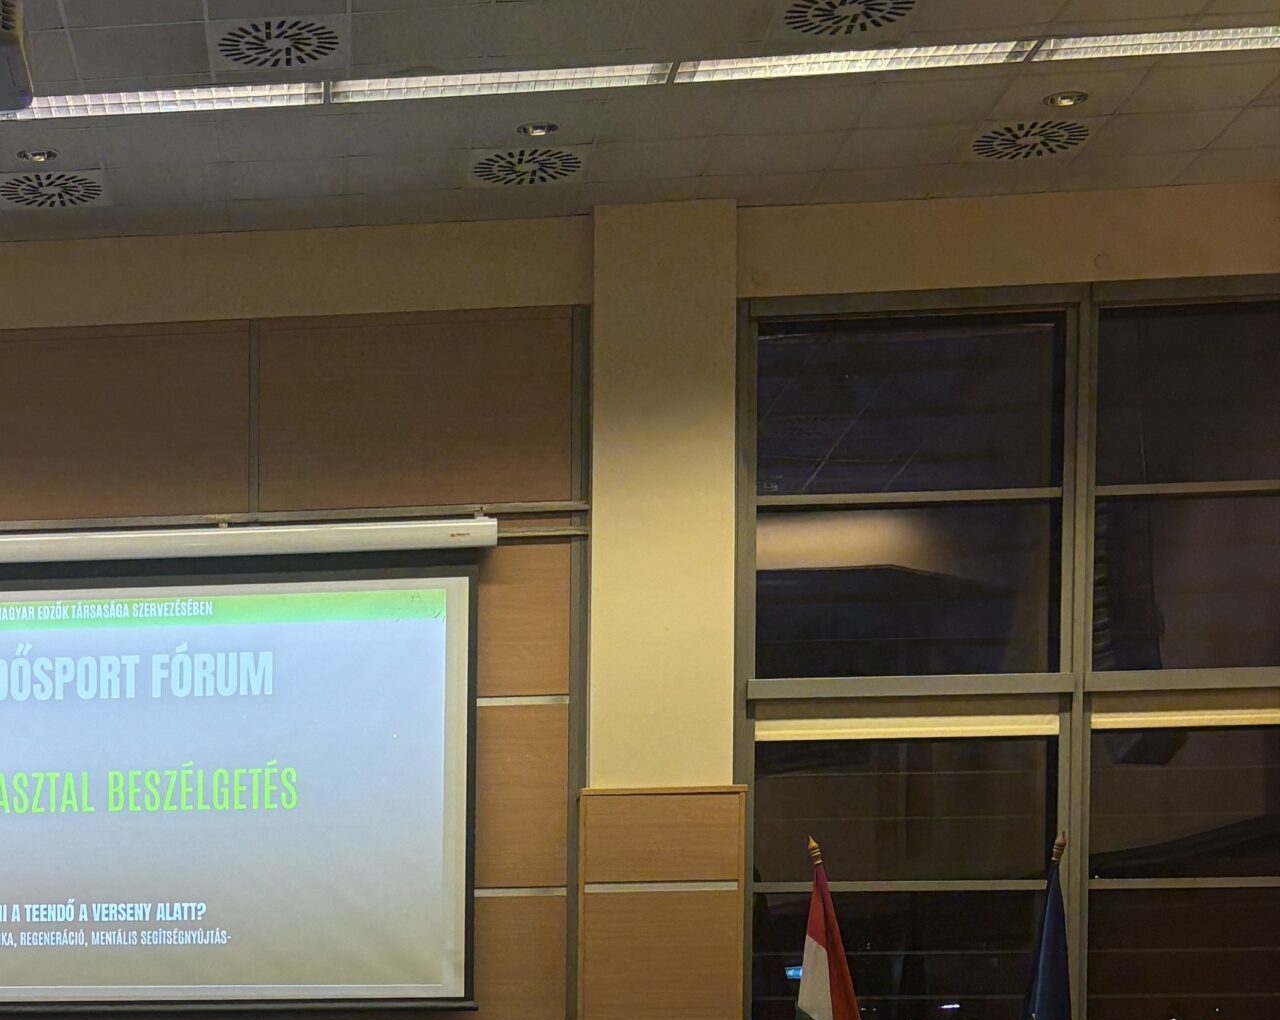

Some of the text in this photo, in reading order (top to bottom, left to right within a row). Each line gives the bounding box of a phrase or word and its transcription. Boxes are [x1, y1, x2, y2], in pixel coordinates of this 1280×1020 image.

[38, 601, 69, 620] EDZŐK
[71, 600, 130, 619] TÁRSASÁGA
[132, 598, 213, 618] SZERVEZÉSÉBEN
[151, 641, 274, 699] FÓRUM
[108, 759, 298, 812] BESZÉLGETÉS
[11, 904, 20, 922] A
[24, 898, 75, 922] TEENDŐ
[79, 903, 88, 921] A
[92, 903, 152, 922] VERSENY
[156, 902, 207, 921] ALATT?
[20, 929, 88, 948] REGENERÁCIÓ,
[91, 928, 138, 945] MENTÁLIS
